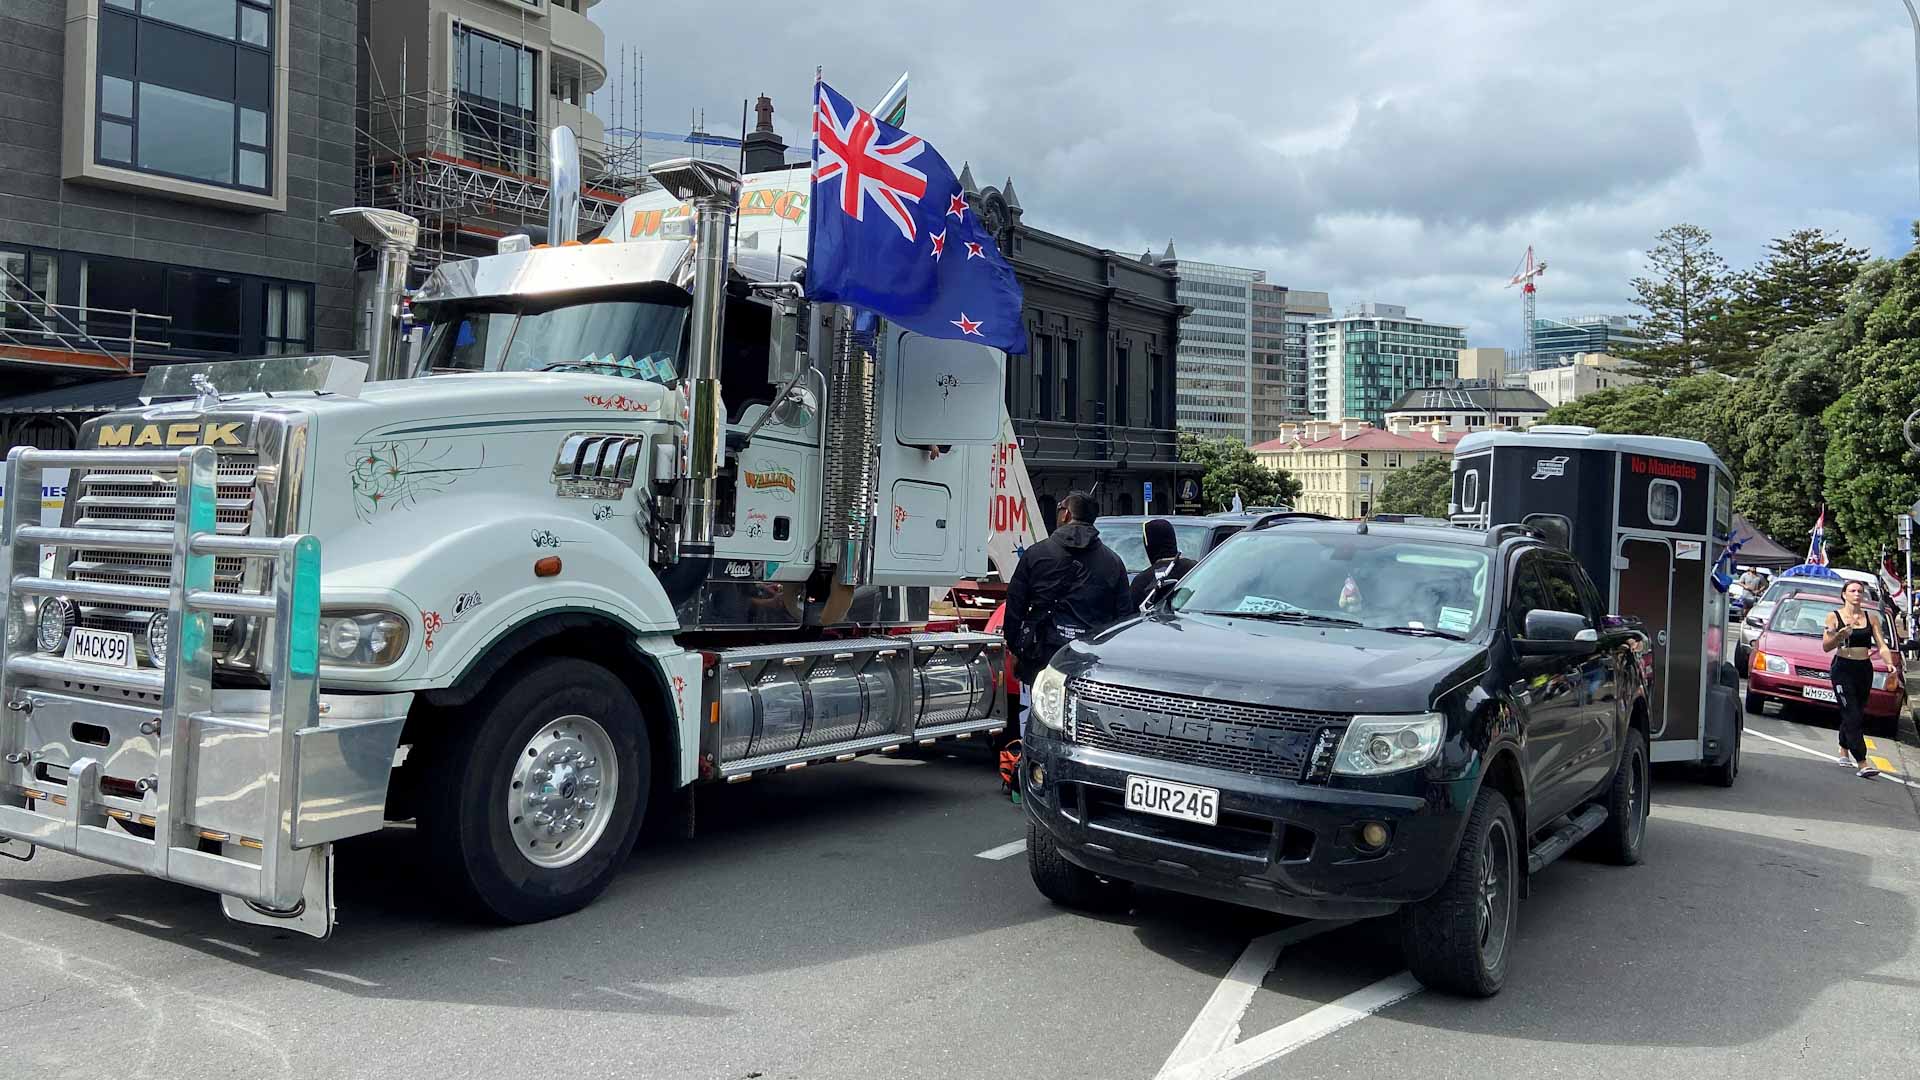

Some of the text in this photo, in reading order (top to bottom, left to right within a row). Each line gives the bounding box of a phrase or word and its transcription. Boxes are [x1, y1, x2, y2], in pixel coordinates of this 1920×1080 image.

[98, 423, 245, 446] MACK
[1631, 456, 1696, 479] No Mandates
[724, 561, 750, 577] Mack
[75, 633, 125, 660] MACK99
[1130, 782, 1213, 819] GUR246
